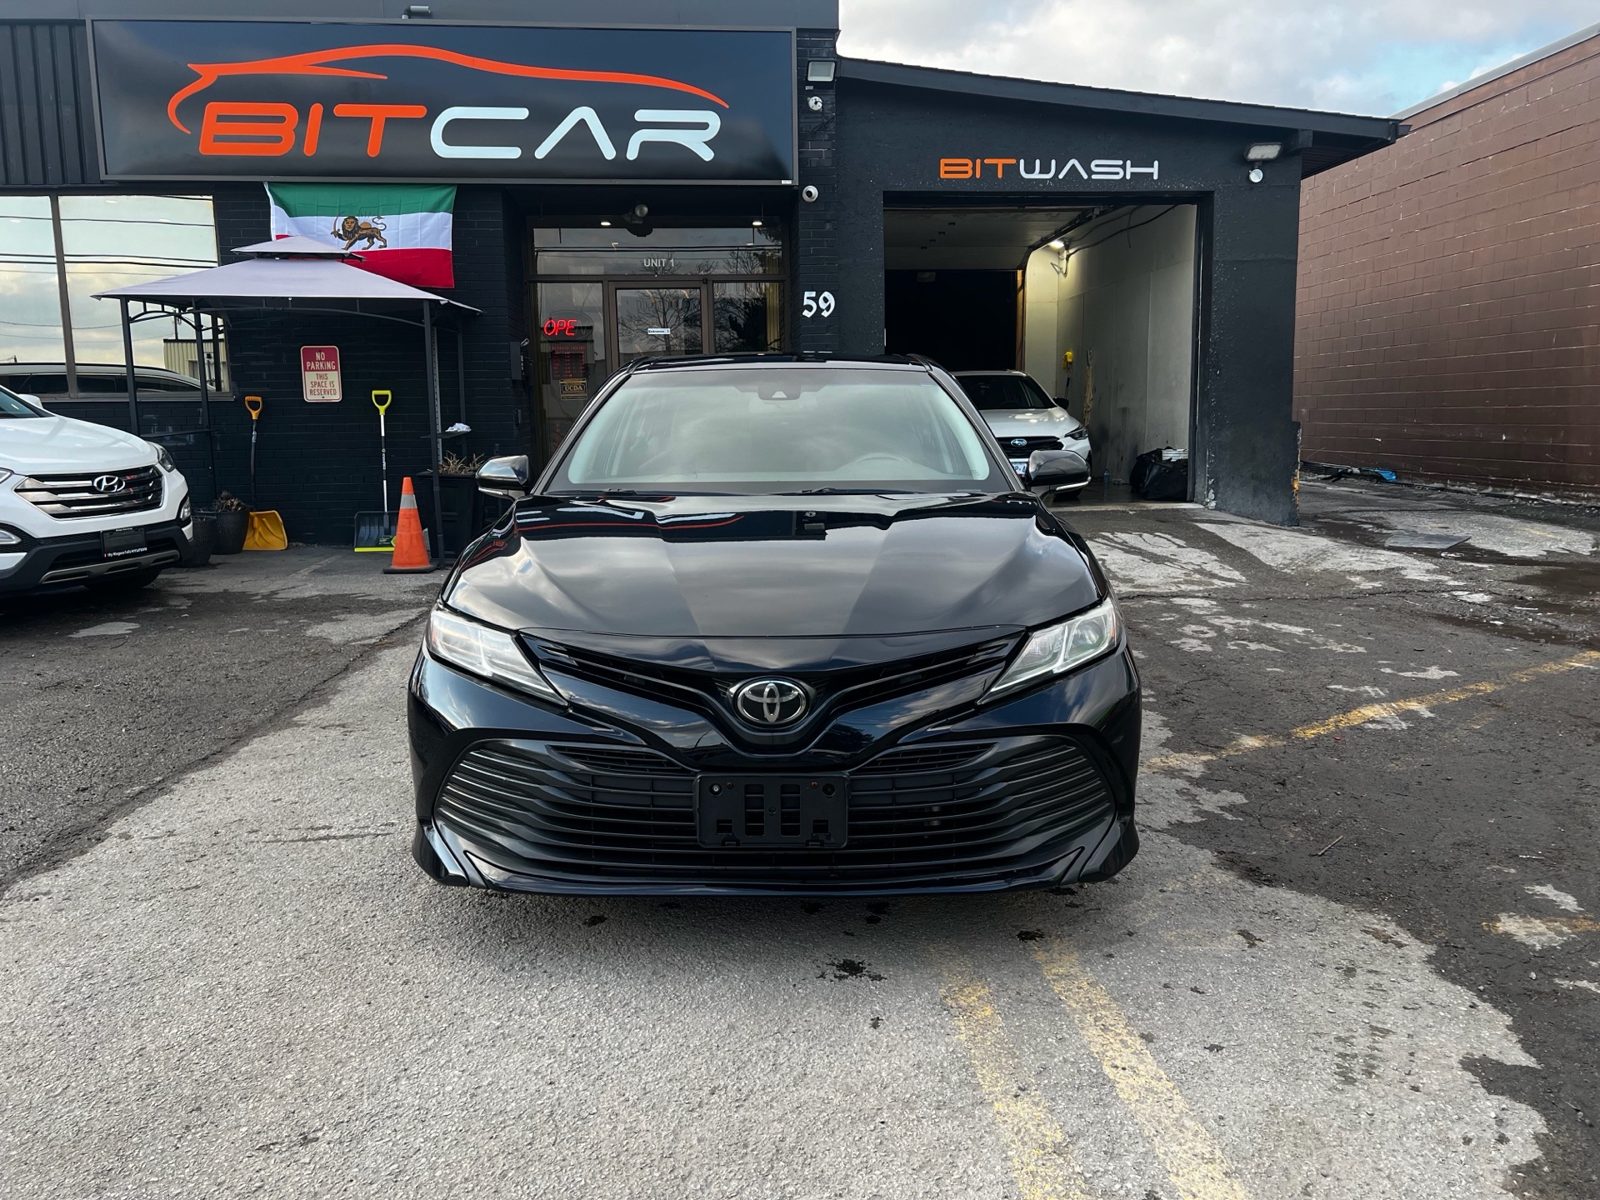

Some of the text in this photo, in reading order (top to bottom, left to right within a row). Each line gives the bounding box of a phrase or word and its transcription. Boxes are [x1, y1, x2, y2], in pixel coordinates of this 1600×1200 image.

[198, 101, 722, 162] BITCAR
[939, 158, 1159, 180] BITWASH
[643, 258, 675, 267] UNIT 1
[802, 291, 836, 318] 59
[315, 351, 326, 361] NO
[306, 361, 336, 371] PARKING
[310, 380, 335, 388] SPACE IS
[309, 388, 337, 396] RESERVED
